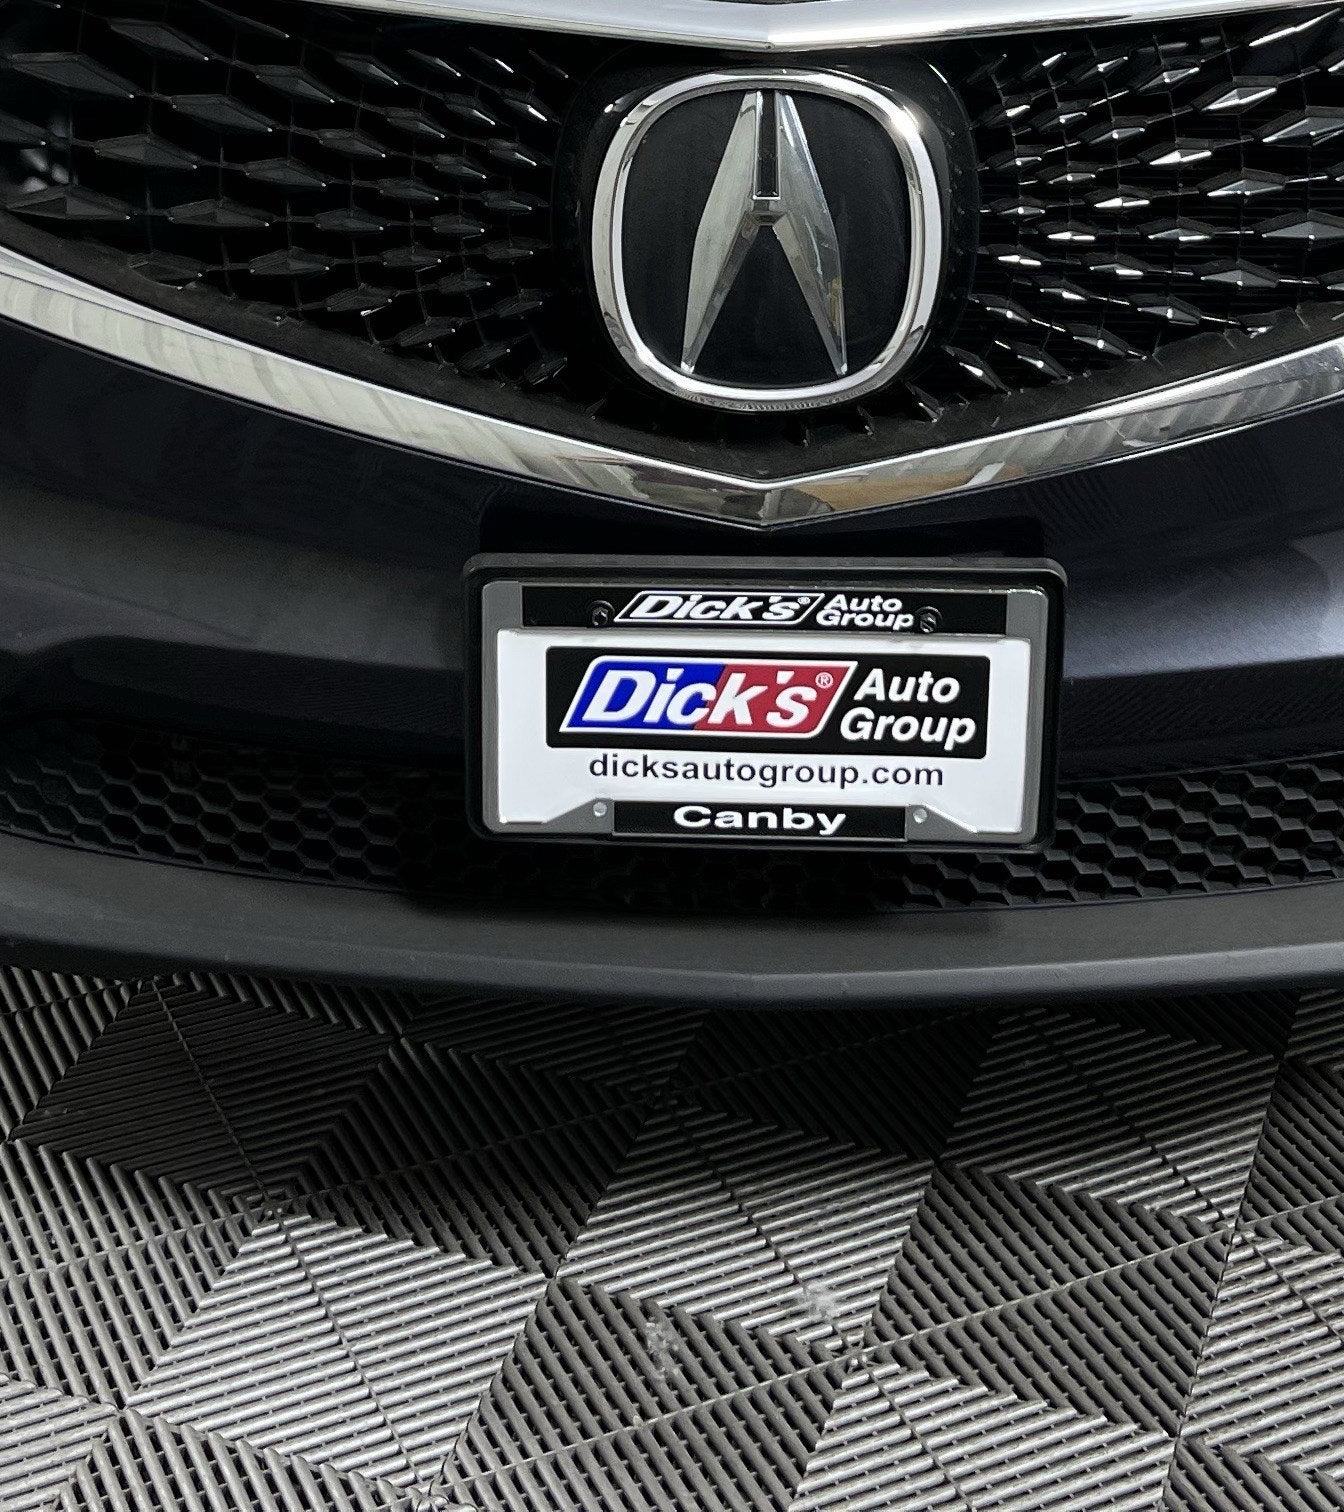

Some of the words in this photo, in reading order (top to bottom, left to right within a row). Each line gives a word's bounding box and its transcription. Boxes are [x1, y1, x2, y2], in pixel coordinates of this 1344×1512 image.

[824, 593, 903, 612] Auto
[815, 609, 914, 631] Group
[853, 667, 960, 704] Auto
[839, 706, 977, 751] Group
[589, 752, 945, 789] dicksautogroup.com
[673, 804, 848, 835] Canby
